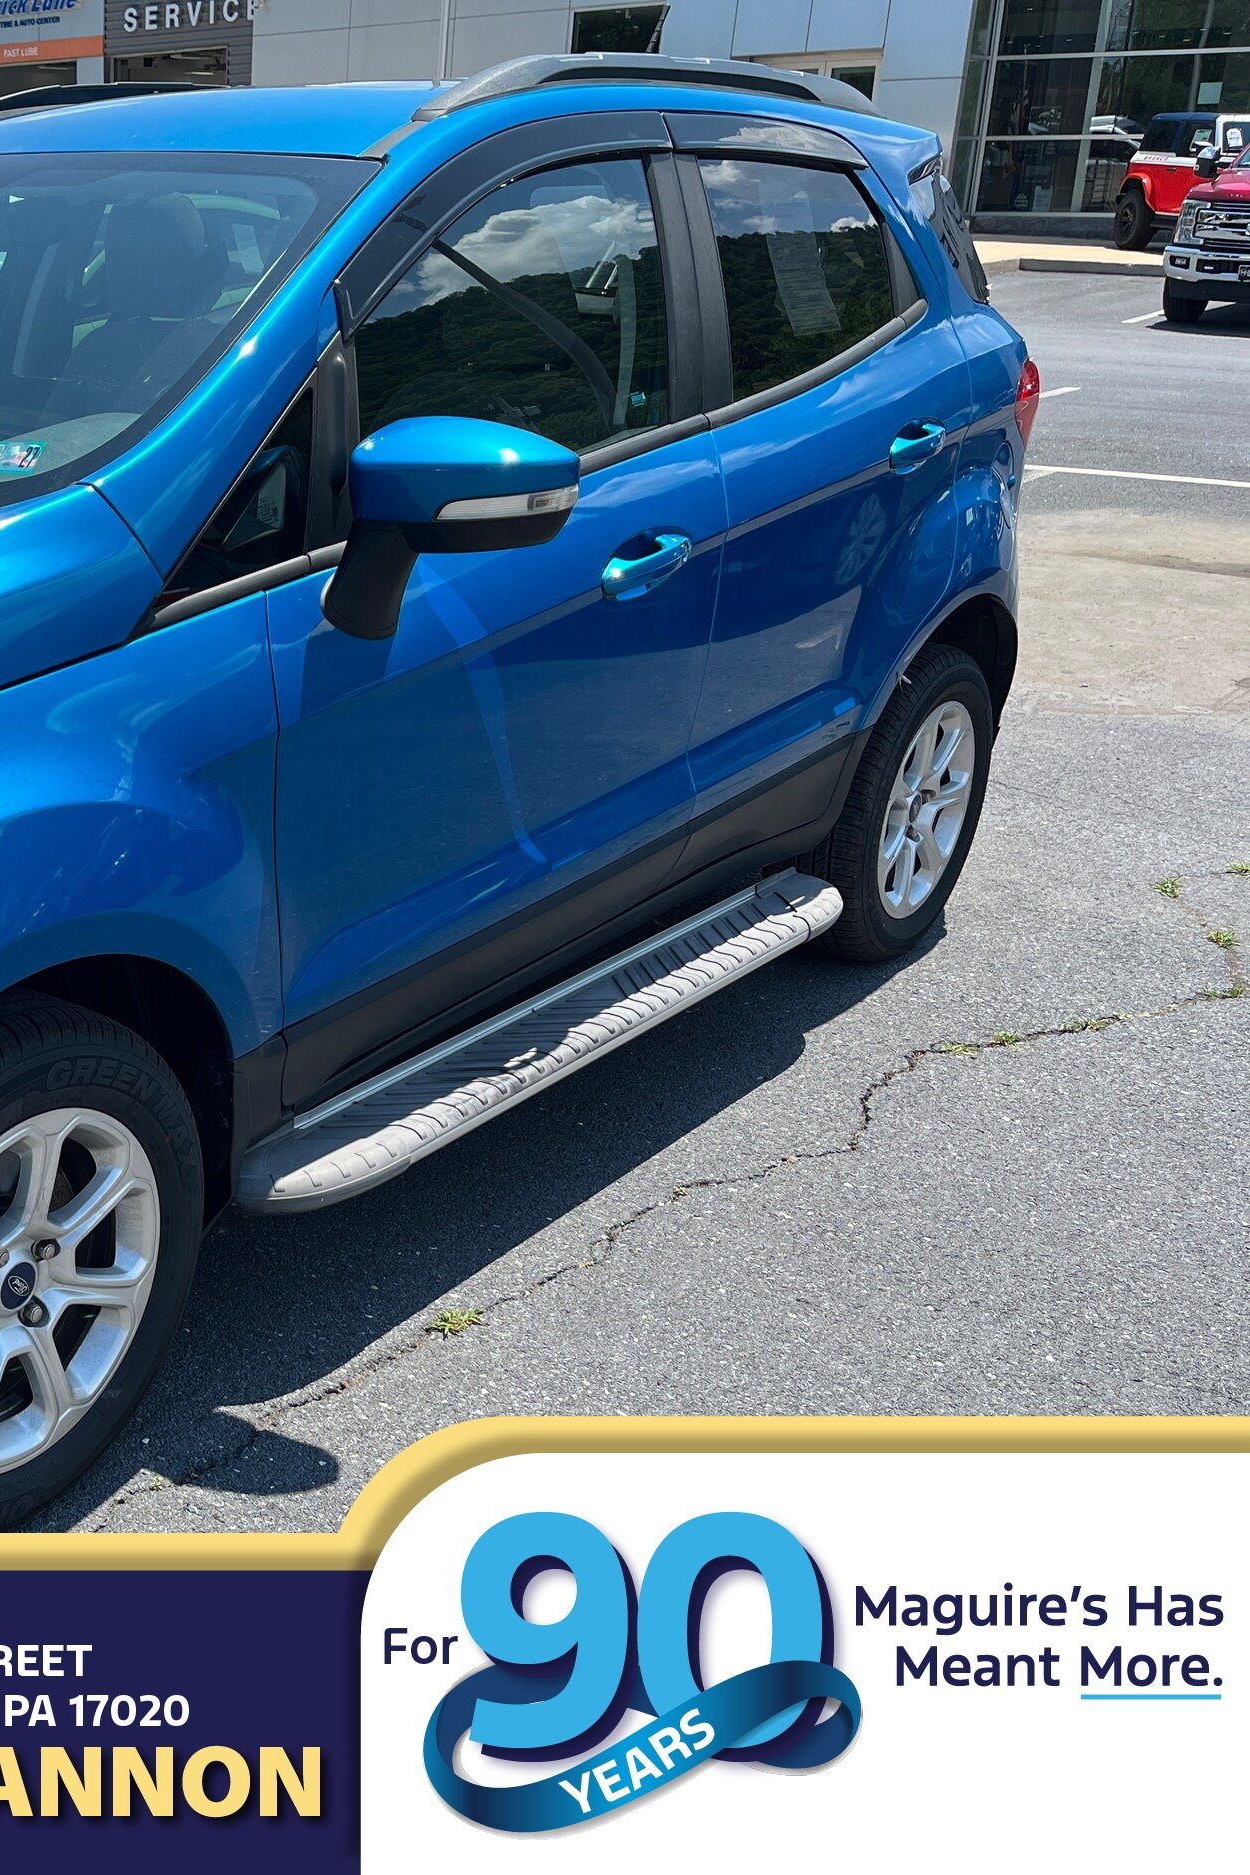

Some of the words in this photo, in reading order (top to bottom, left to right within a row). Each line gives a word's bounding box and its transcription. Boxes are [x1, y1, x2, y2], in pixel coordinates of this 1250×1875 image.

[3, 48, 20, 58] FAST
[21, 46, 39, 56] LUBE
[19, 447, 40, 468] 27
